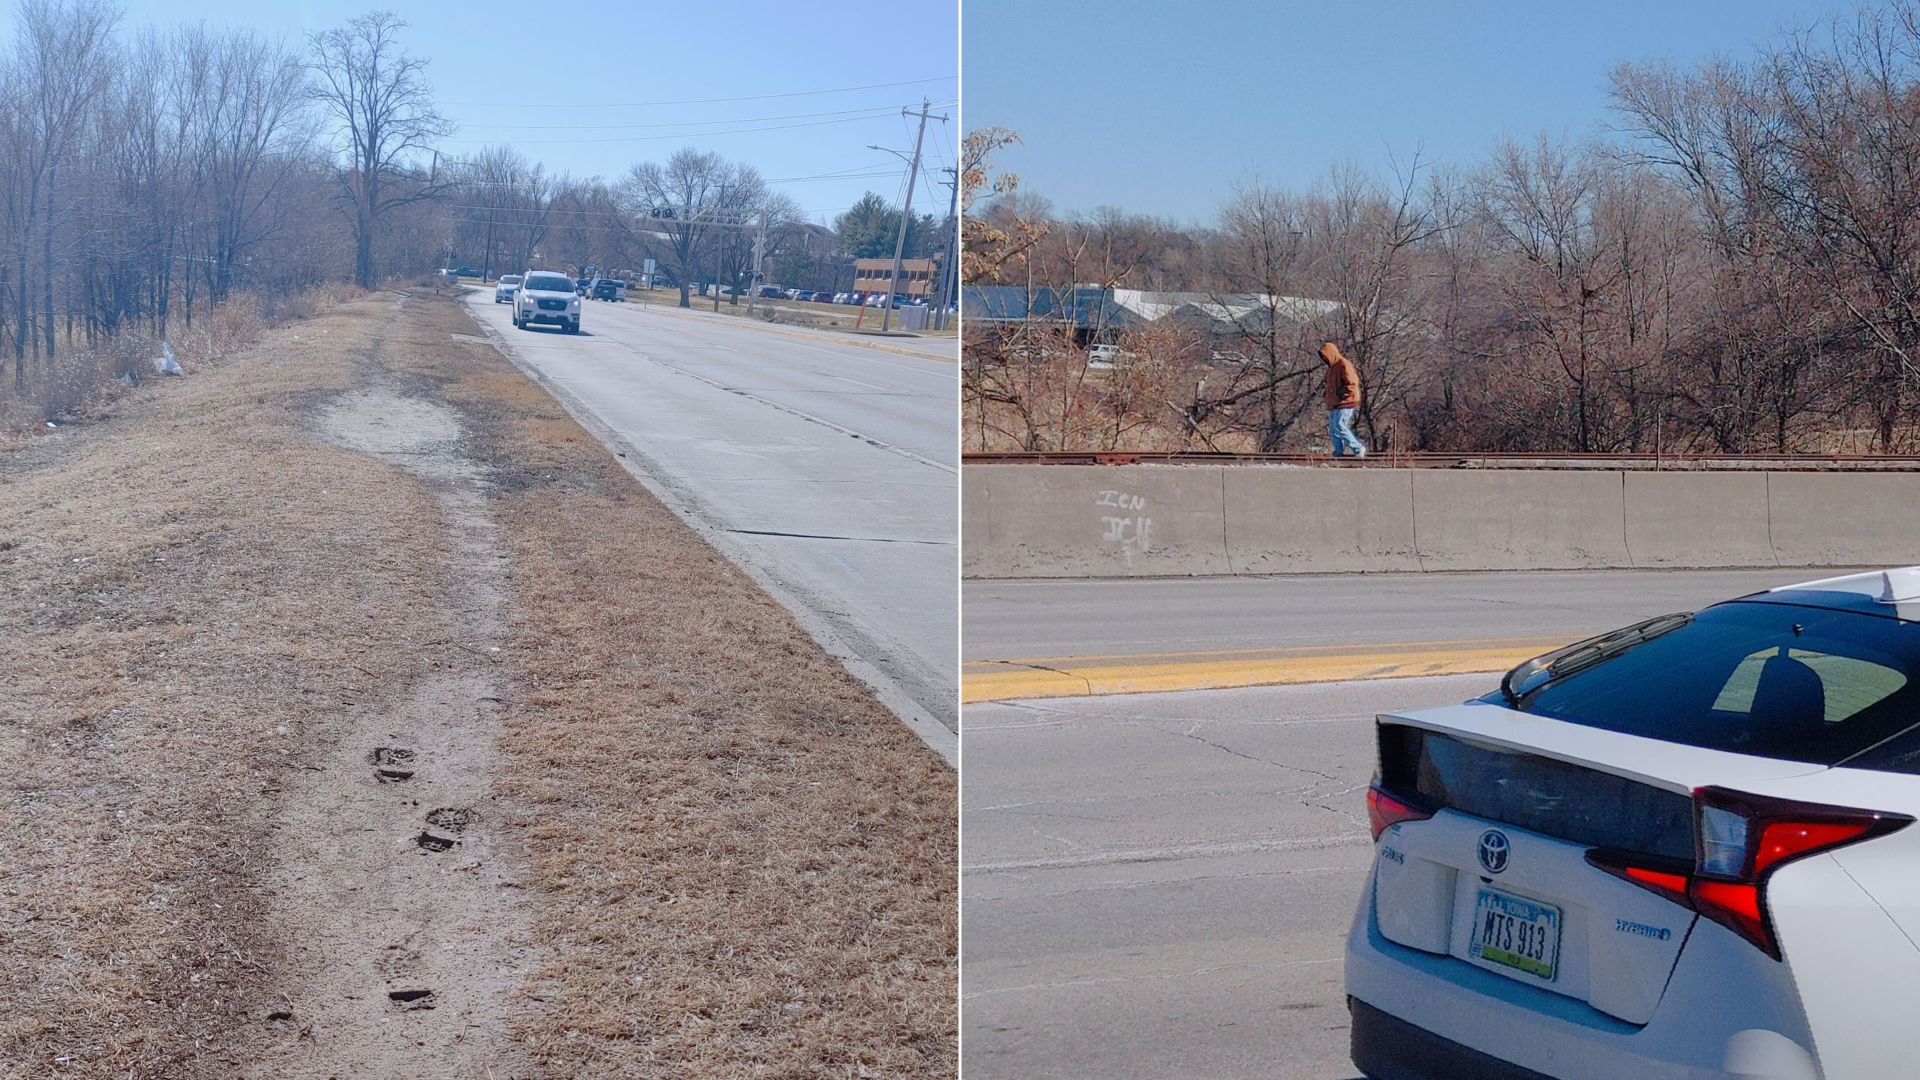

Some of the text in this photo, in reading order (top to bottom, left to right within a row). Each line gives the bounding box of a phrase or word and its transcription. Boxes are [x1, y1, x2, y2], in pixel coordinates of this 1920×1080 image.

[1482, 911, 1546, 960] MTS 913
[1616, 919, 1662, 938] HYBRID
